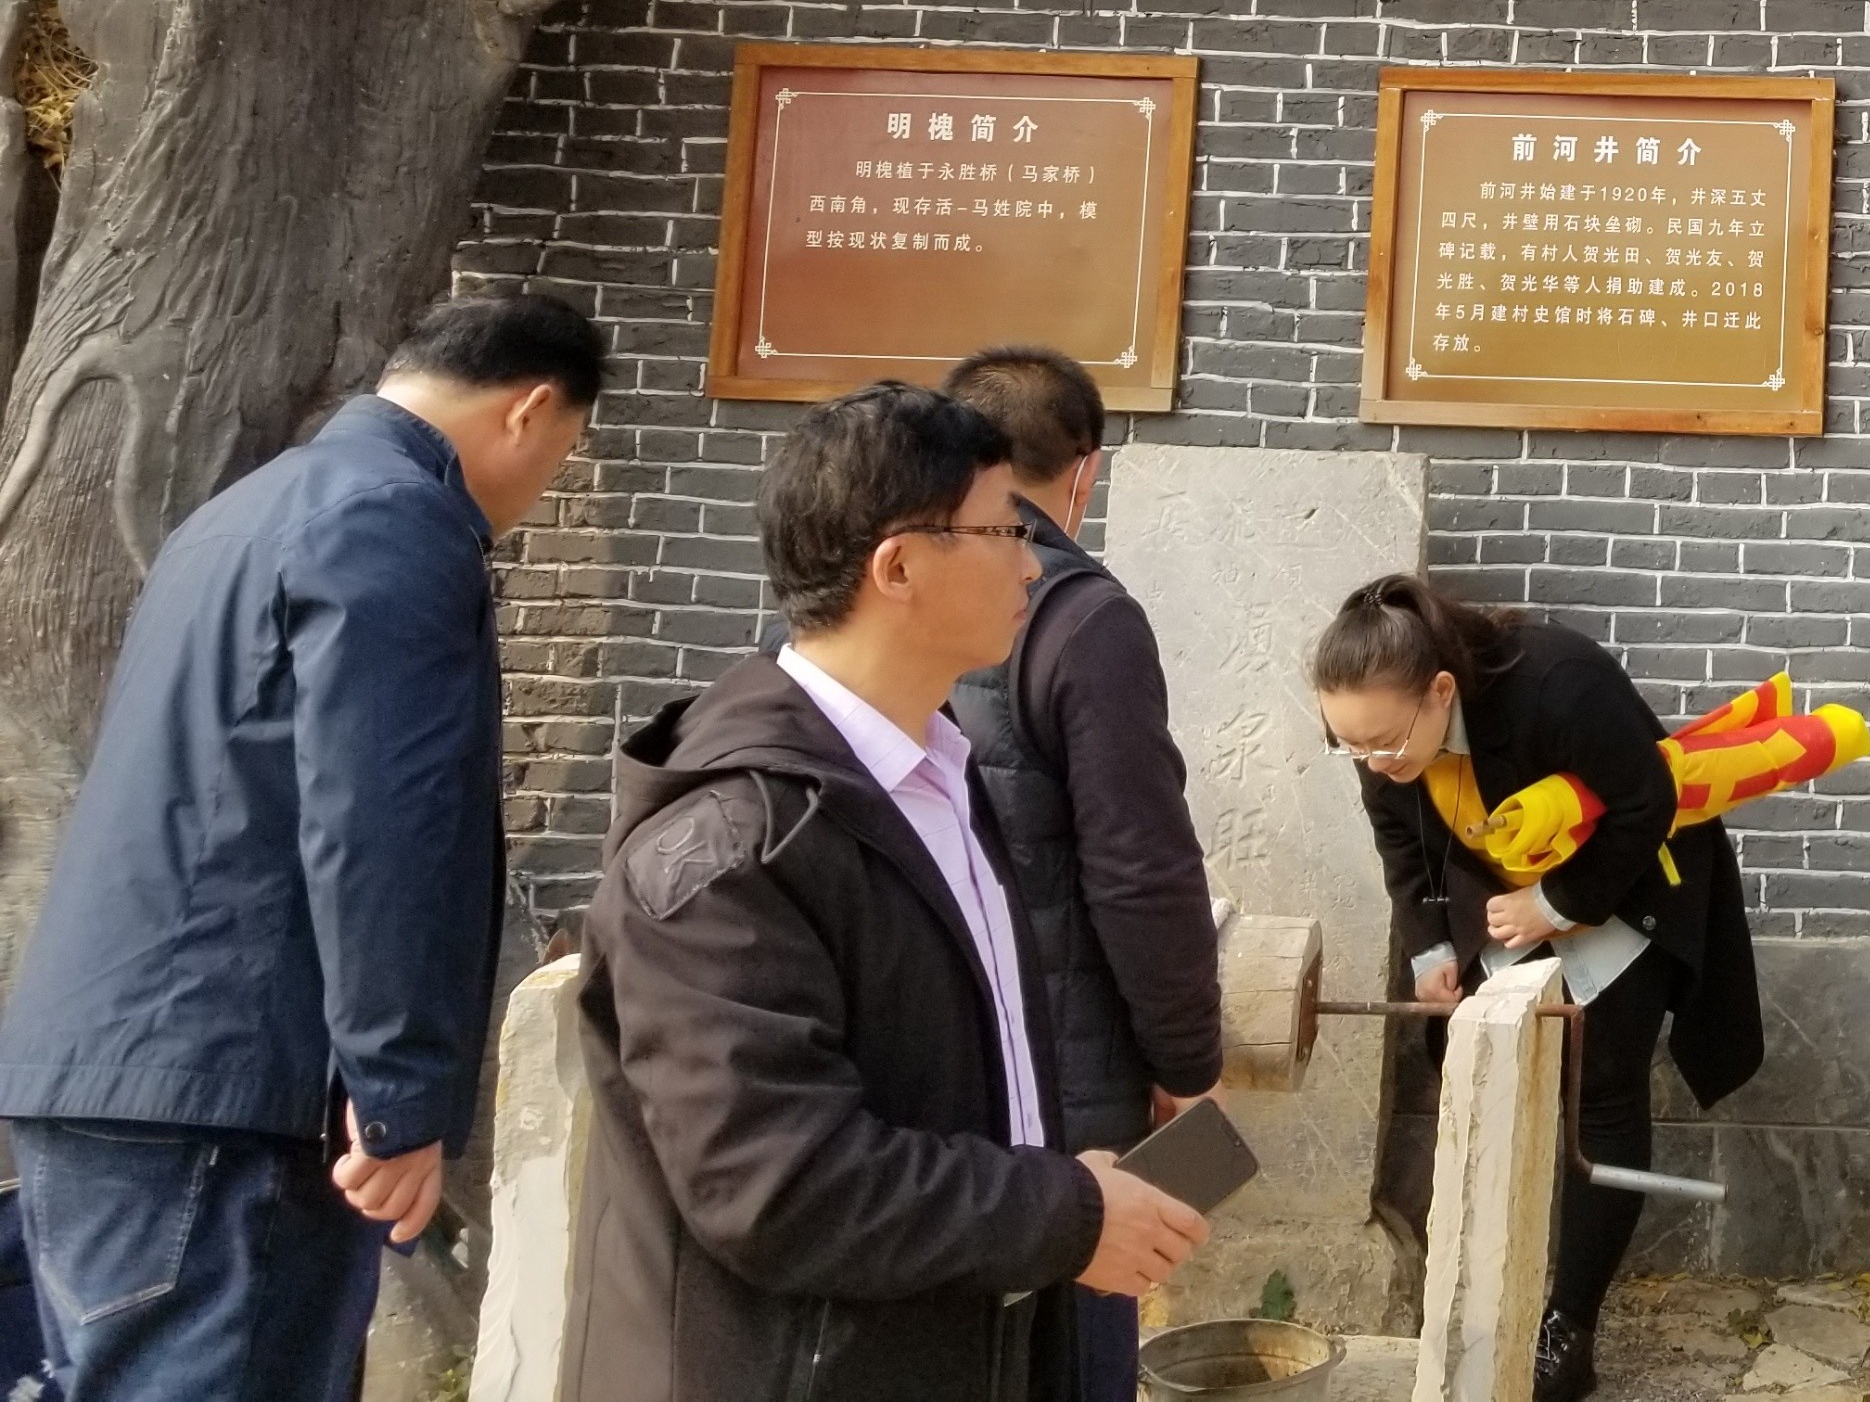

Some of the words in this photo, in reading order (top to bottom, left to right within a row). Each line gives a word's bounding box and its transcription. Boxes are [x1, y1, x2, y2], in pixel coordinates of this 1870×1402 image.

[887, 112, 1039, 144] 明槐简介
[1512, 134, 1702, 166] 前河井简介
[1432, 334, 1484, 353] 存放。
